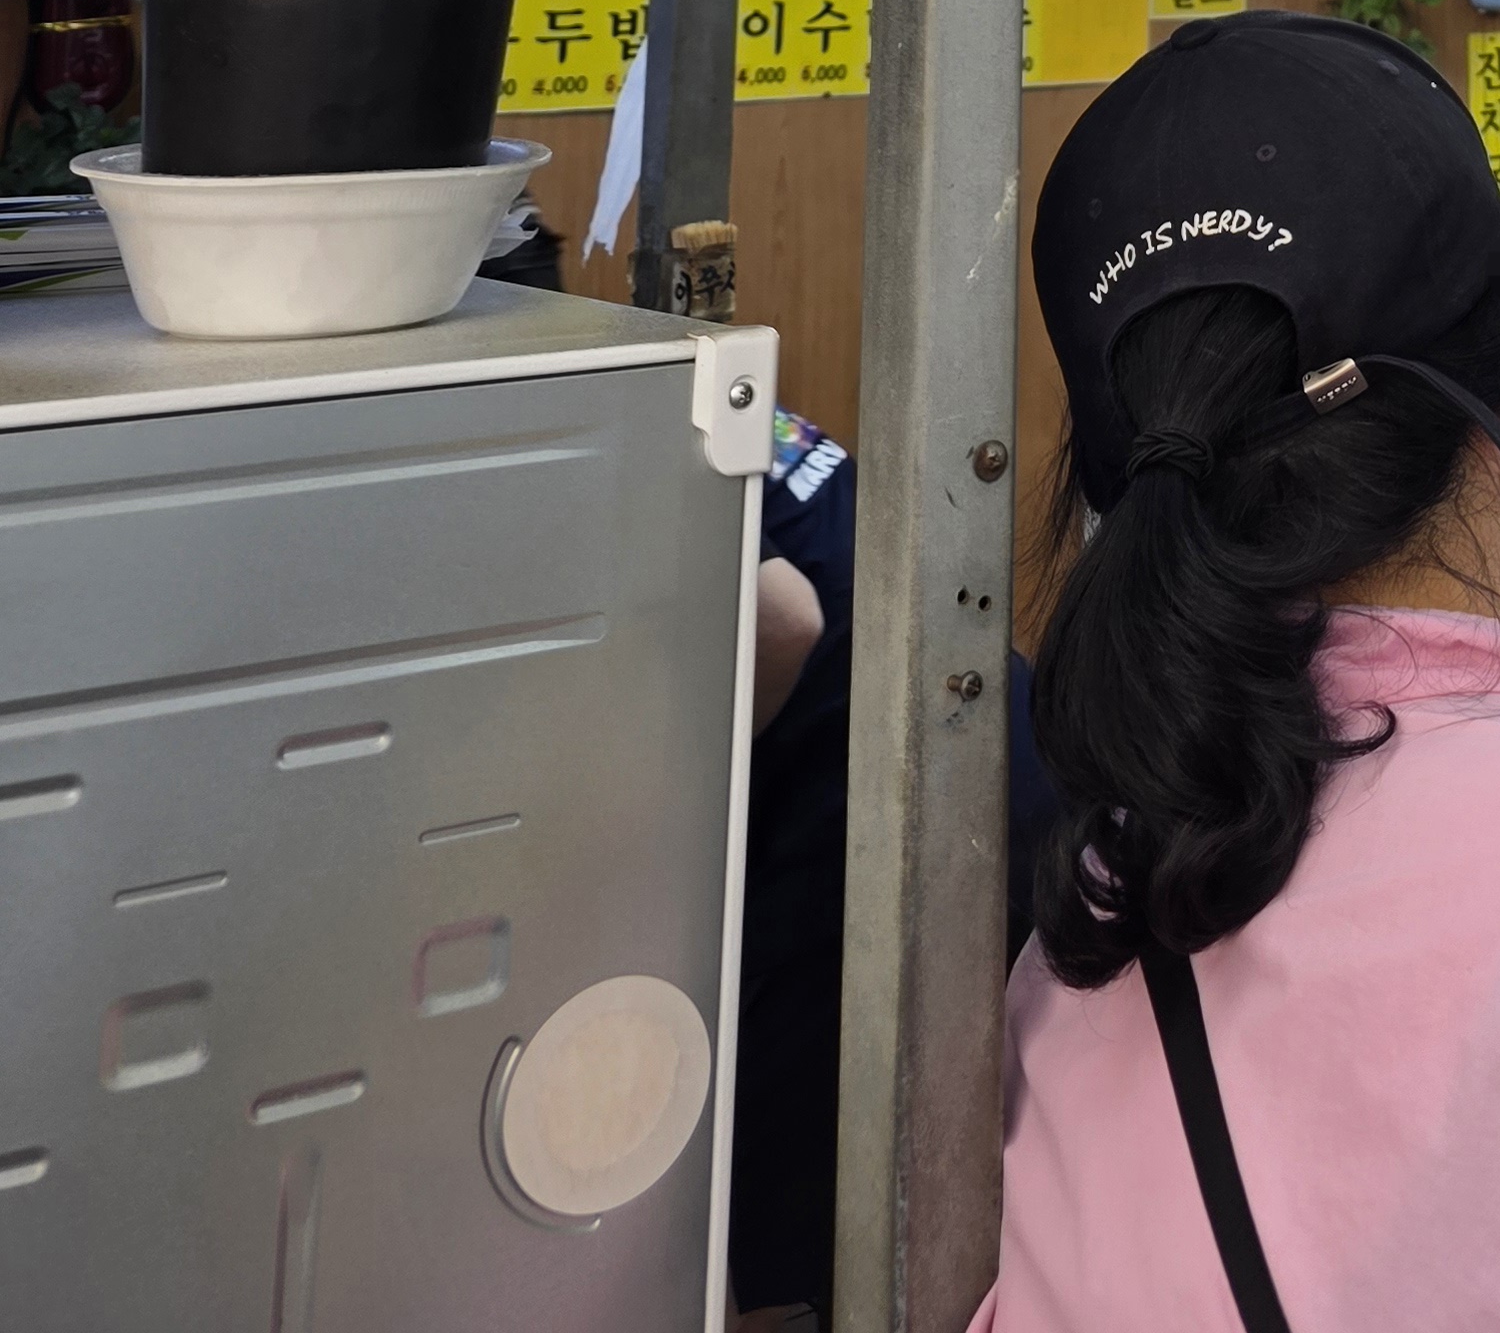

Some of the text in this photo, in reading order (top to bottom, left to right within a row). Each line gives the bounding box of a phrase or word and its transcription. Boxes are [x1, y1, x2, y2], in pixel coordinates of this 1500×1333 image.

[1088, 207, 1294, 306] WHO IS NERDY?
